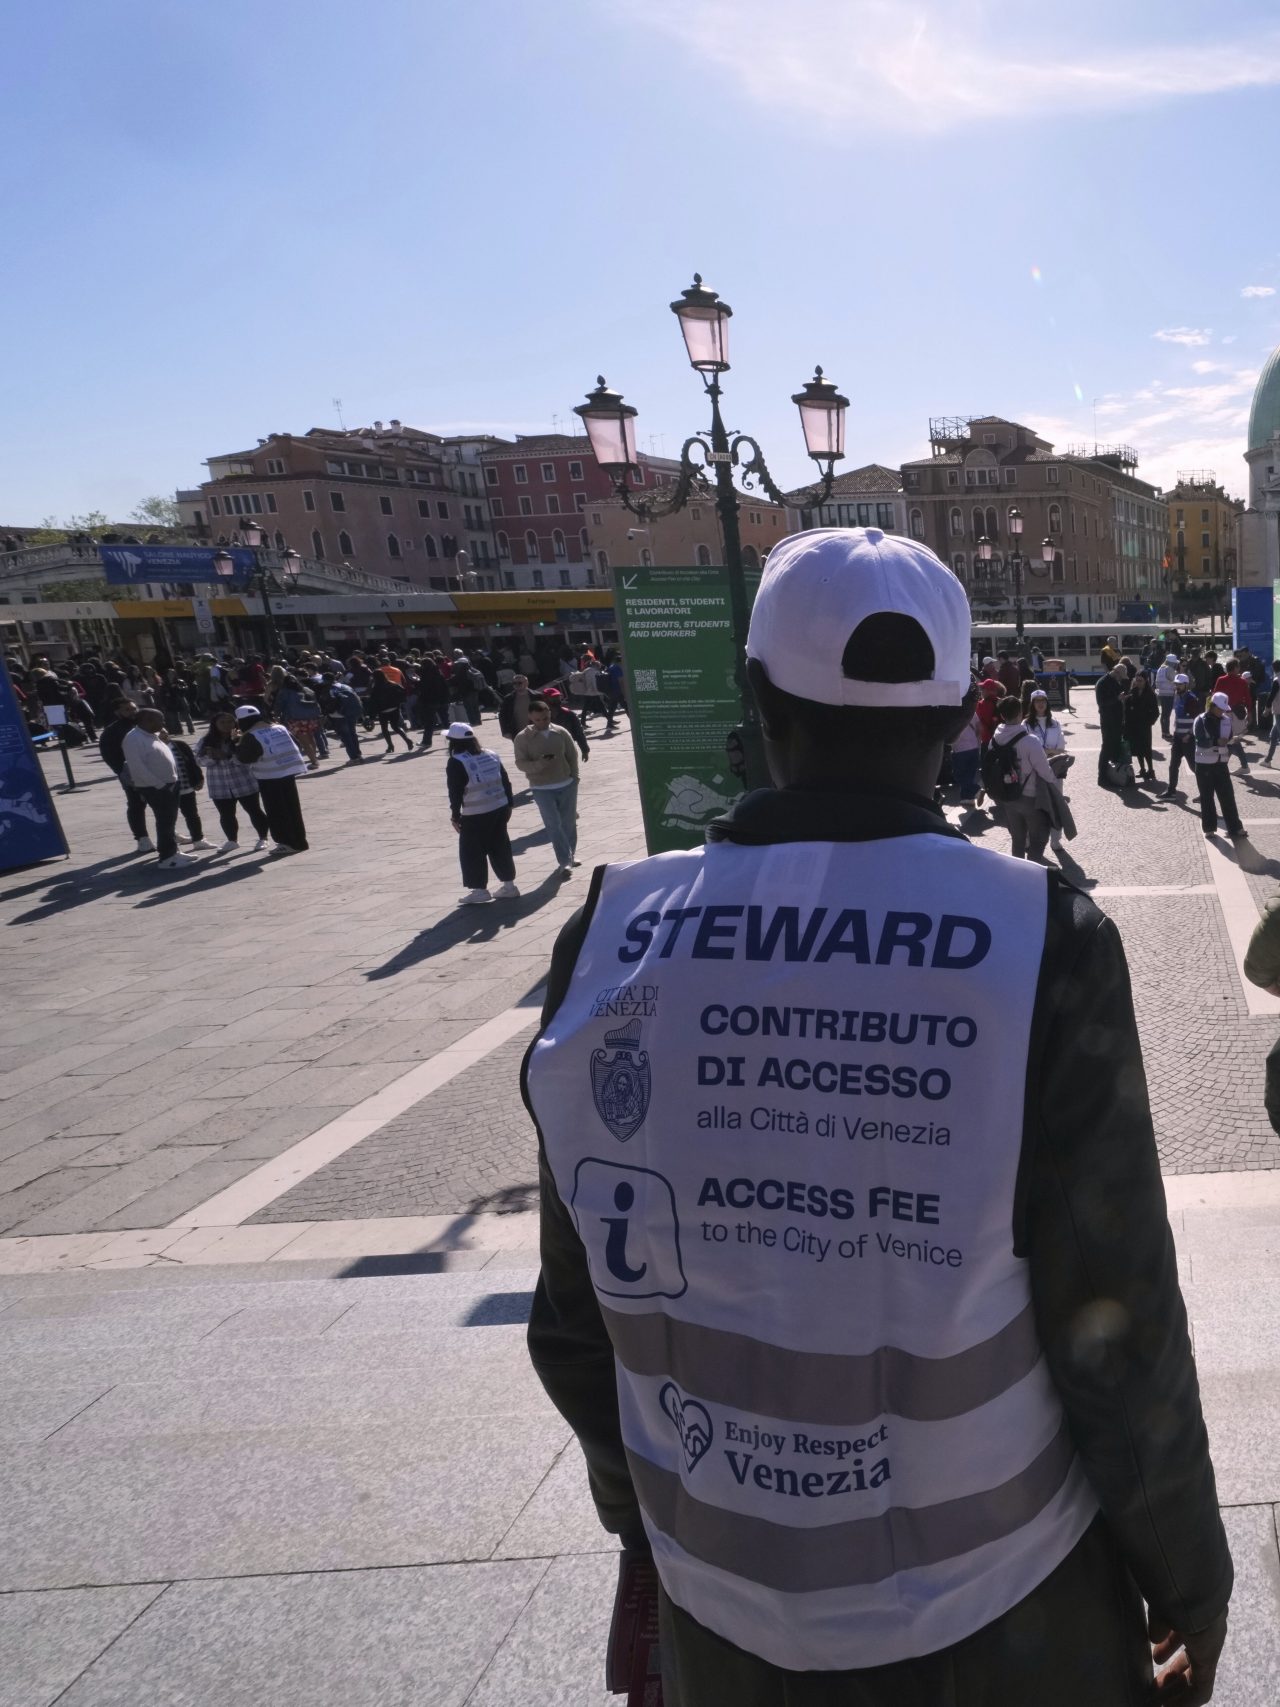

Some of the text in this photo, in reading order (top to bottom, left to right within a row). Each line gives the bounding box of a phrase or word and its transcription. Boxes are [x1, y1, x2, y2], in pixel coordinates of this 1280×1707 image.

[626, 598, 725, 607] RESIDENTI, STUDENTI
[629, 620, 730, 629] RESIDENTS, STUDENTS
[630, 630, 696, 638] AND WORKERS
[618, 904, 992, 969] STEWARD
[589, 1002, 657, 1017] VENEZIA
[642, 986, 660, 1000] DI
[700, 1004, 978, 1048] CONTRIBUTO
[698, 1056, 952, 1100] DI ACCESSO
[697, 1106, 951, 1146] alla Città di Venezia
[698, 1178, 940, 1225] ACCESS FEE
[701, 1221, 963, 1268] to the City of Venice
[724, 1421, 888, 1460] Enjoy Respect
[724, 1450, 891, 1498] Venezia
